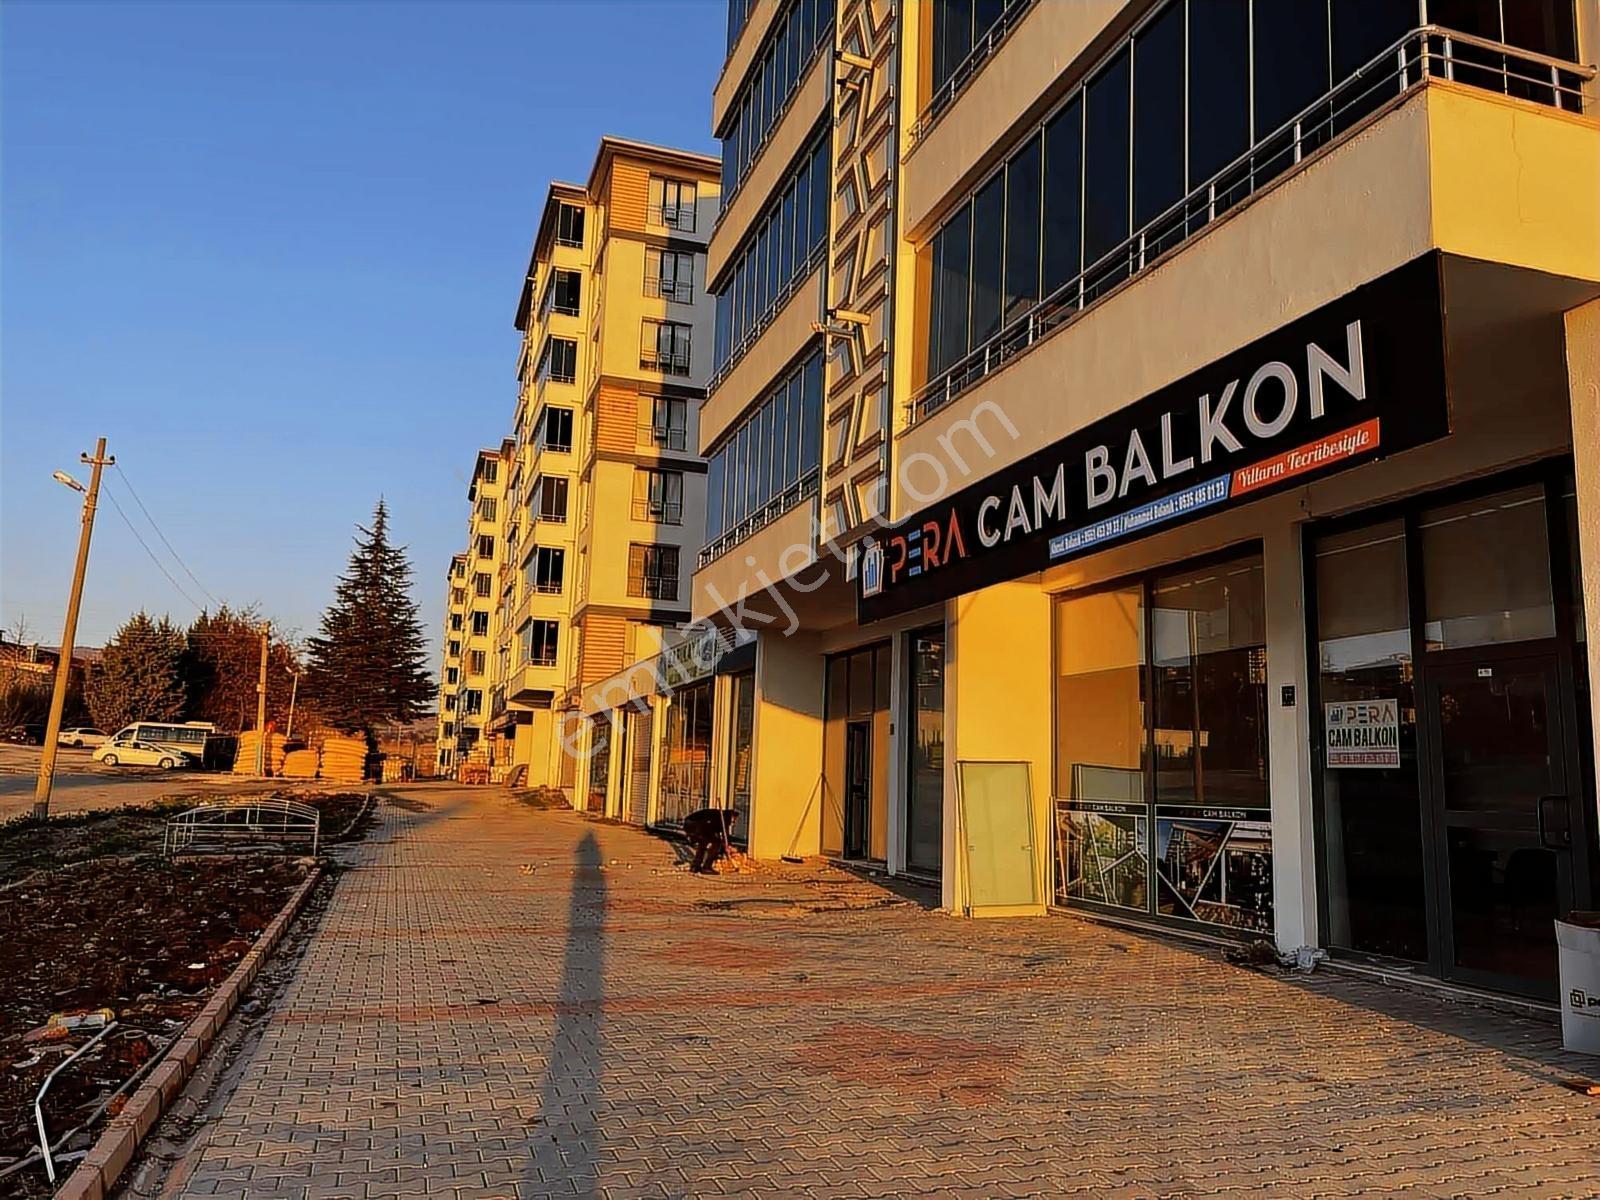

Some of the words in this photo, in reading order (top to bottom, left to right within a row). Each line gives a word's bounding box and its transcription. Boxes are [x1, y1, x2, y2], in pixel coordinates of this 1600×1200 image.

[892, 507, 965, 583] PERA
[977, 463, 1066, 548] CAM
[1085, 319, 1366, 510] BALKON
[1287, 430, 1370, 470] Tecrübesiyle
[1346, 704, 1394, 724] PERA
[1328, 728, 1353, 748] CAM
[1354, 726, 1397, 748] BALKON
